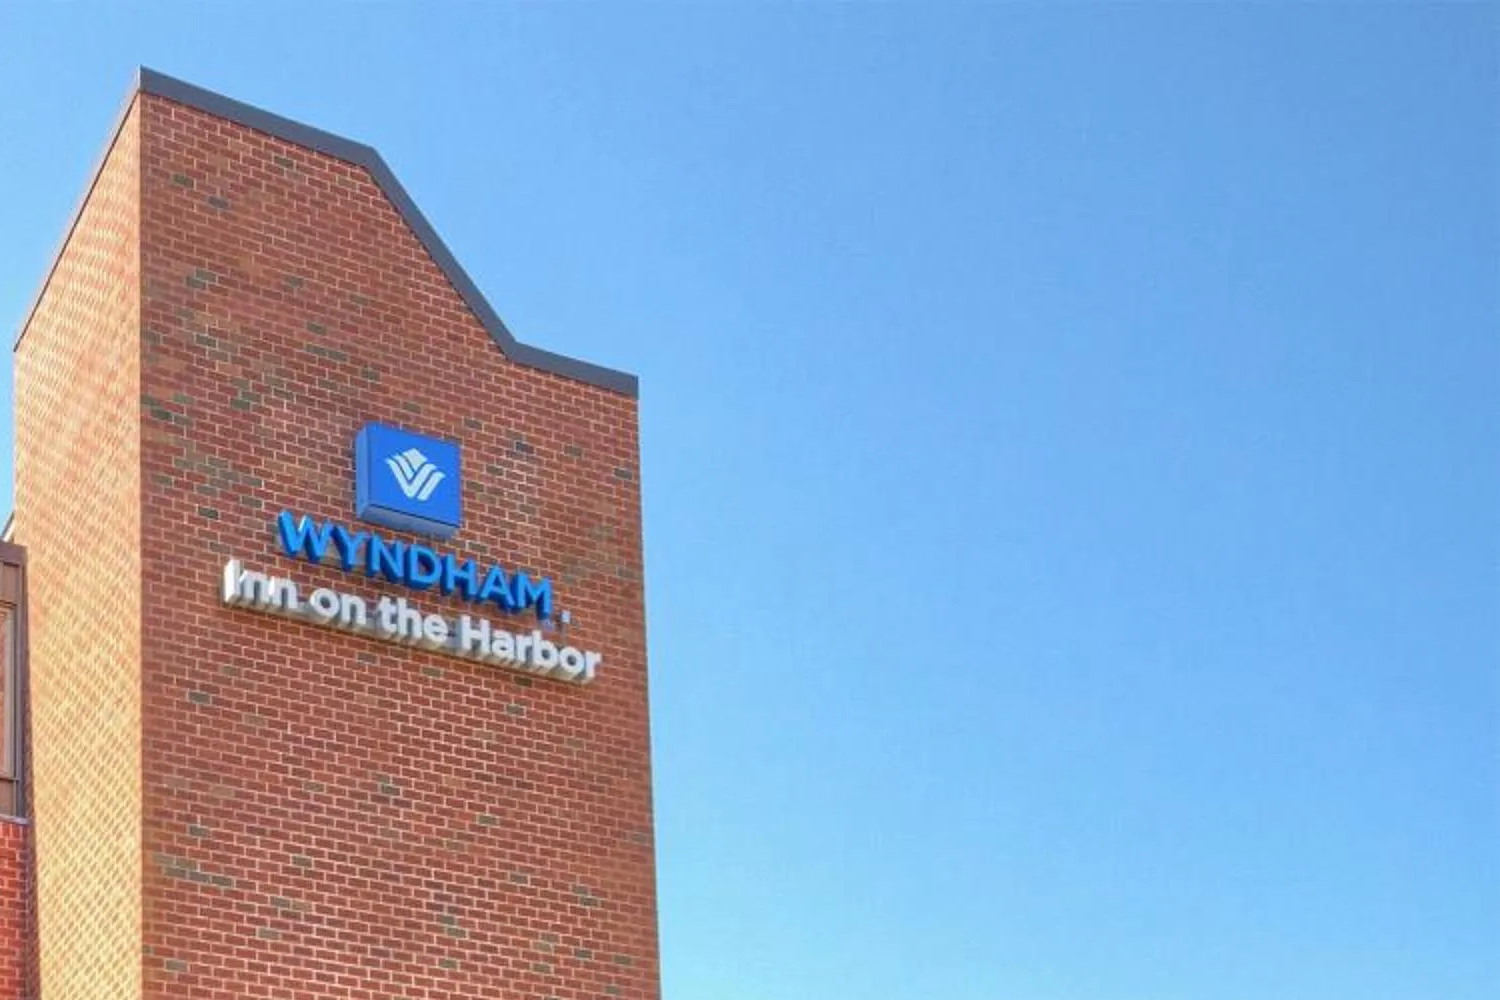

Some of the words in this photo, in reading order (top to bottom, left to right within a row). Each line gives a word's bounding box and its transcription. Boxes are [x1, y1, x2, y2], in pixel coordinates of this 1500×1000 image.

[223, 558, 299, 610] Inn
[309, 587, 367, 626] on
[376, 595, 449, 643] the
[460, 614, 602, 680] Harbor
[277, 509, 554, 621] WYNDHAM
